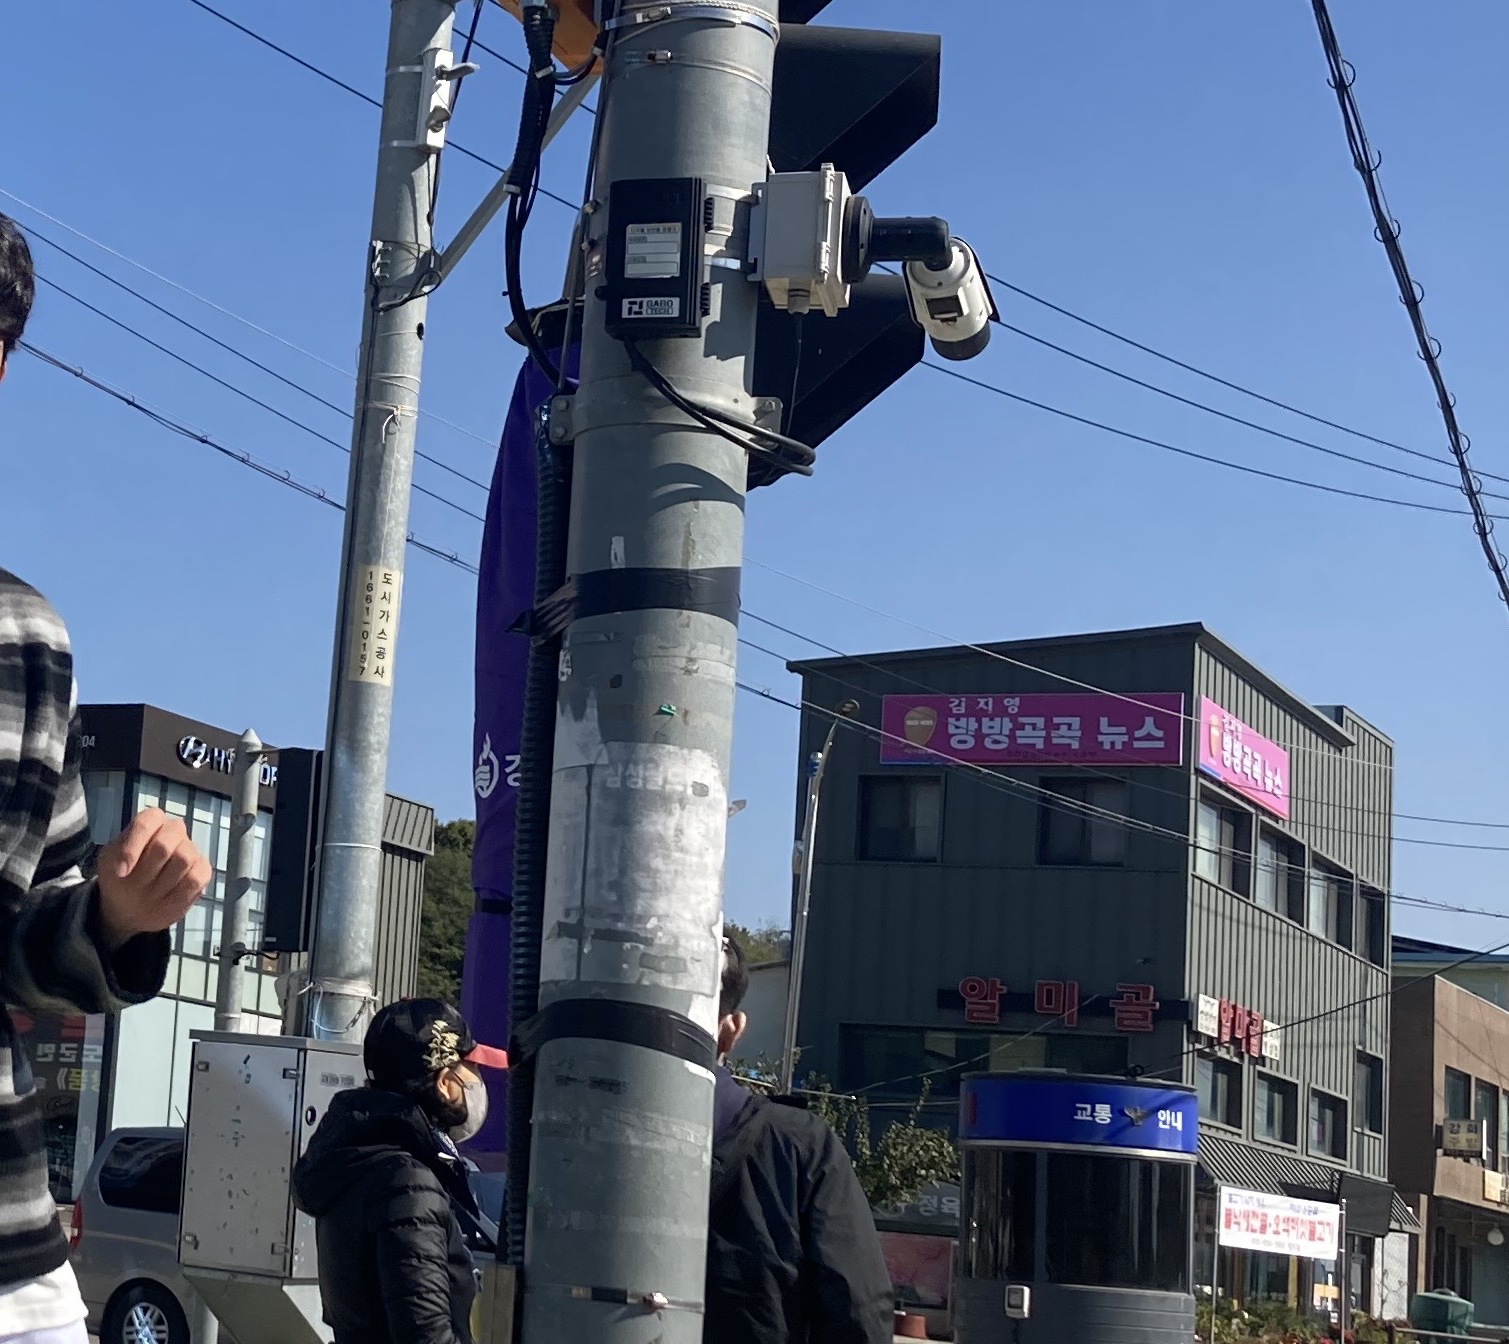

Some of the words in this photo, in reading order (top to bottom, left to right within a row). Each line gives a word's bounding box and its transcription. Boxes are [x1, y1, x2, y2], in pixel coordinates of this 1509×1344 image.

[359, 570, 374, 676] 1661-0157
[373, 573, 393, 678] 도시가스공사
[80, 735, 96, 748] 04
[947, 716, 1083, 750] 방방곡곡
[1097, 716, 1166, 750] 뉴스
[1222, 731, 1262, 787] 방방곡곡
[1264, 758, 1284, 799] 뉴스
[958, 976, 1160, 1032] 알미골
[1073, 1103, 1112, 1125] 교통
[1157, 1109, 1183, 1131] 안내
